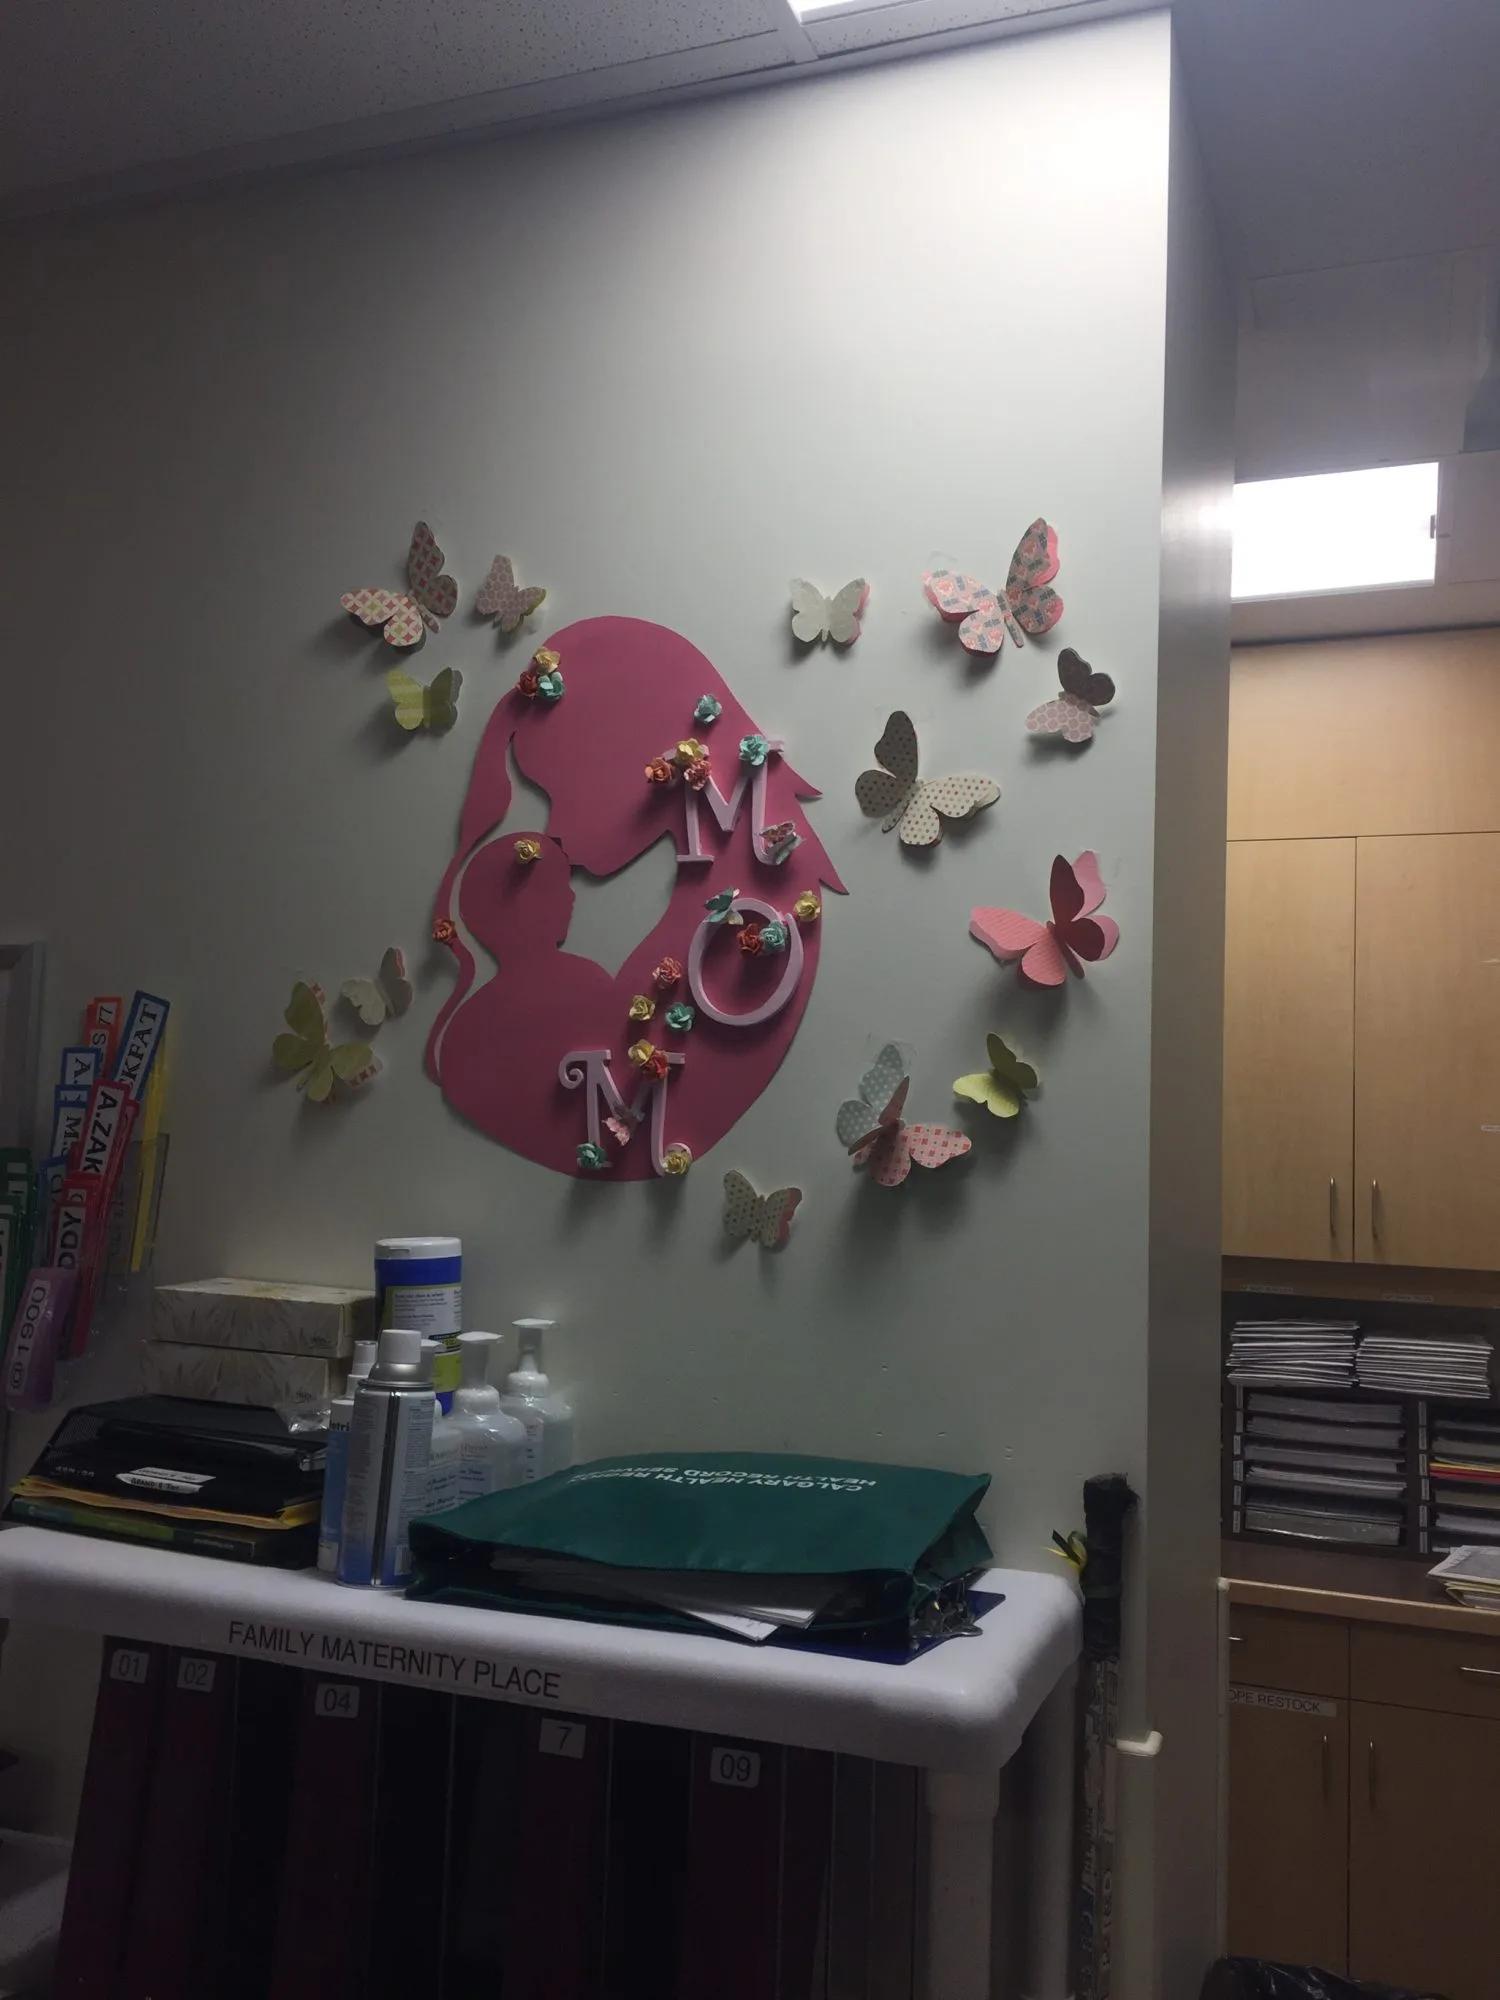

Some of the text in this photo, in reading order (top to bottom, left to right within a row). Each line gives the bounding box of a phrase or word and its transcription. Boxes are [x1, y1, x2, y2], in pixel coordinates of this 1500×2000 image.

[655, 1472, 746, 1485] HEALTH
[683, 1469, 779, 1479] RECORD
[746, 1478, 863, 1492] CALGARY
[783, 1474, 876, 1487] HEALTH
[117, 1653, 141, 1677] 01
[227, 1620, 563, 1700] FAMILY MATERNITY PLACE
[183, 1663, 208, 1687] 02
[322, 1688, 351, 1713] 04
[1257, 1693, 1321, 1713] RESTOCK
[557, 1725, 573, 1751] 7
[720, 1753, 752, 1782] 09
